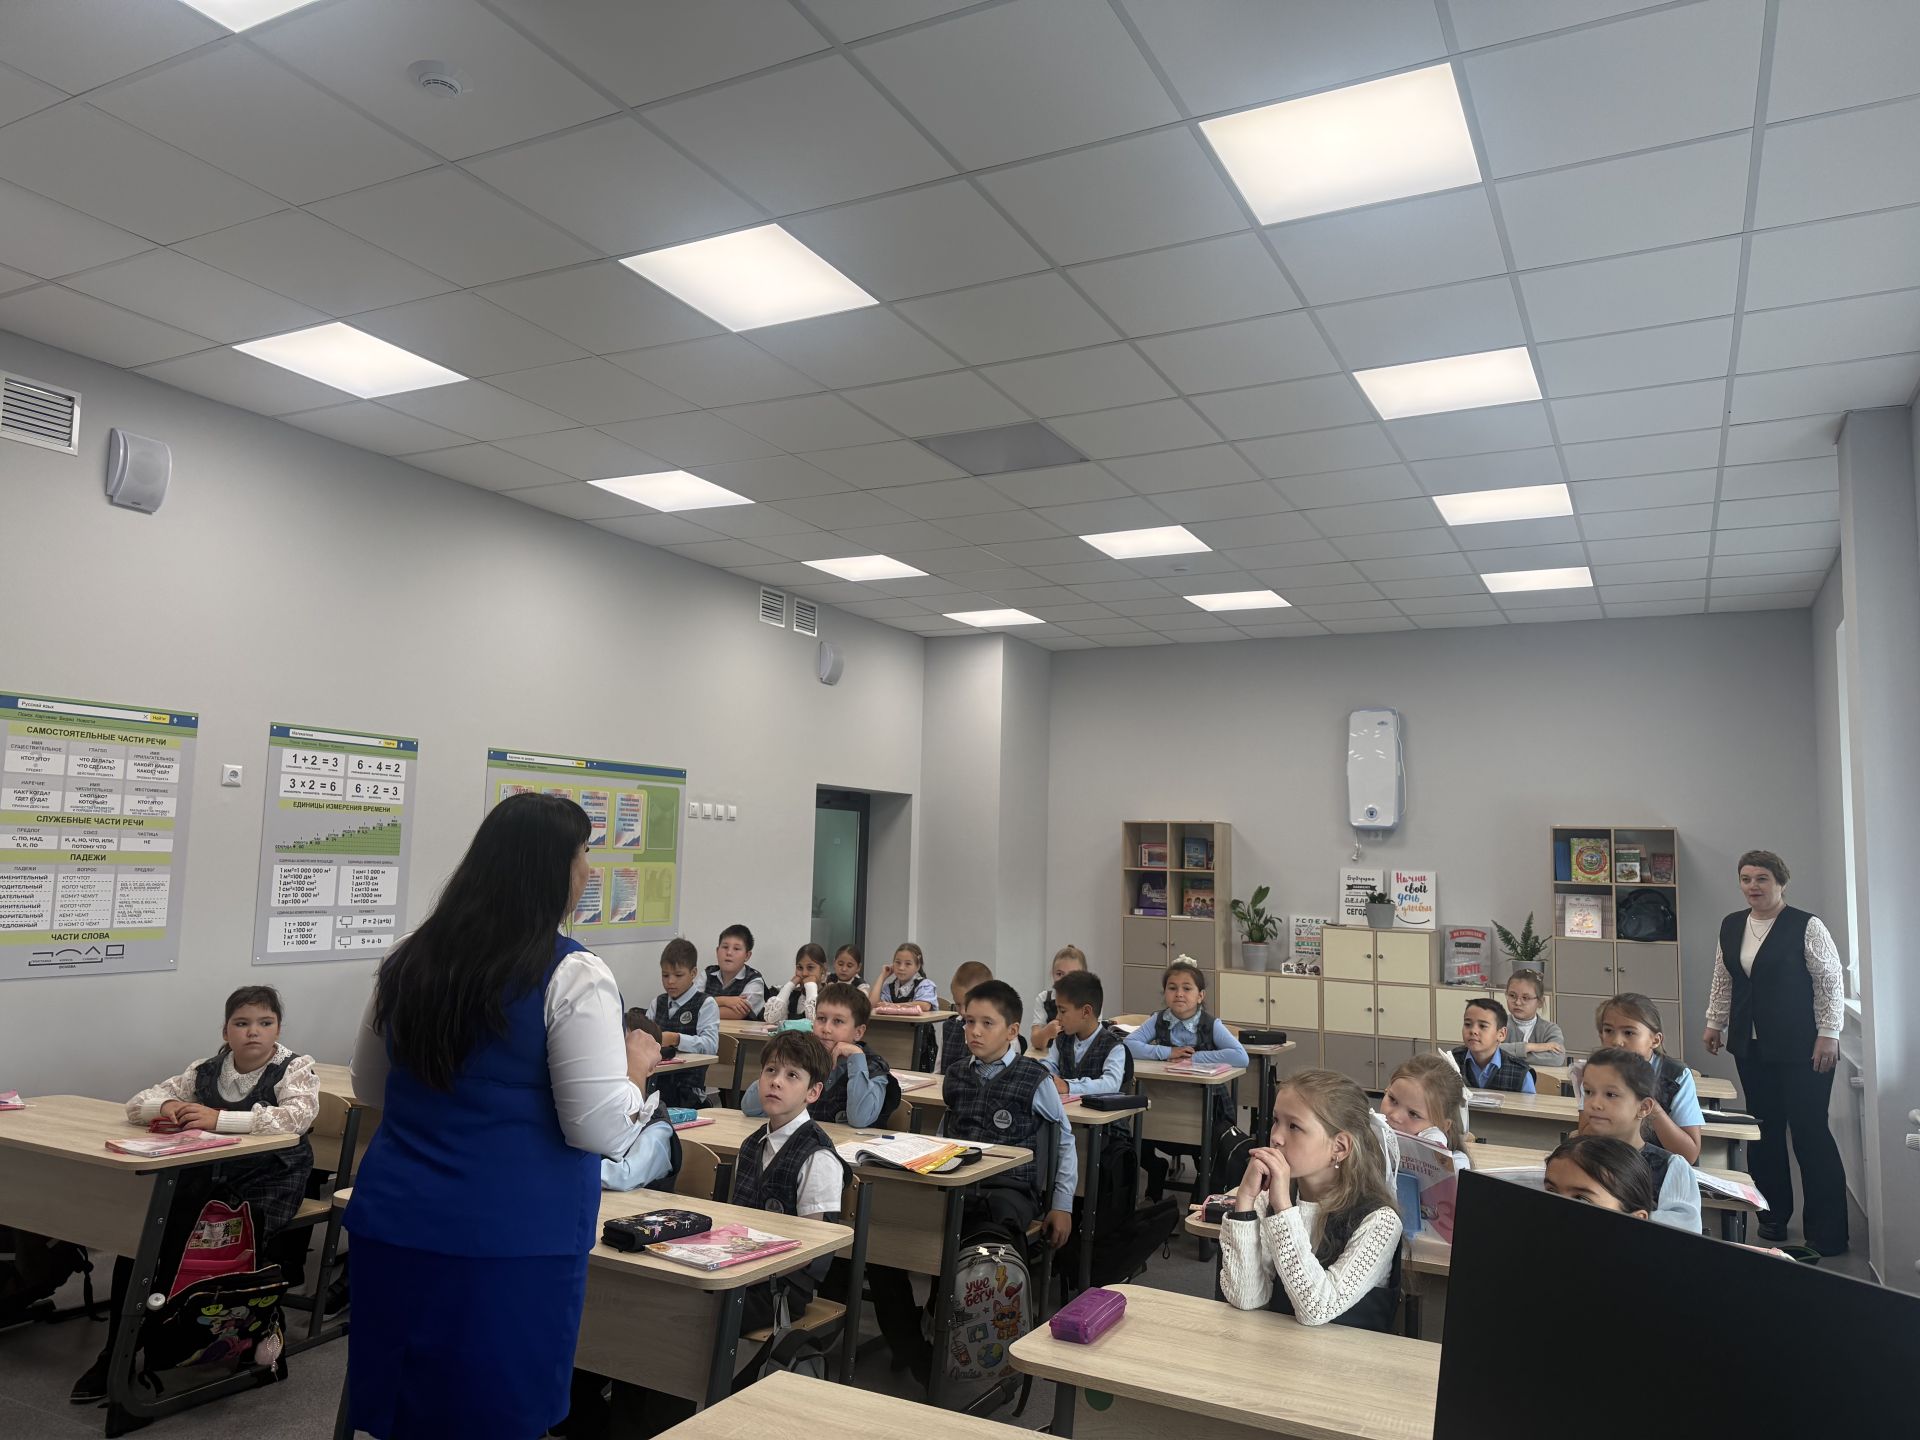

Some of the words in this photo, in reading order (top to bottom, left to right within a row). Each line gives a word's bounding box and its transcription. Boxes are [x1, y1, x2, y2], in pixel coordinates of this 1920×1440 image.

[26, 726, 116, 740] САМОСТОЯТЕЛЬНЫЕ
[118, 736, 144, 744] ЧАСТИ
[10, 744, 62, 752] СУЩЕСТВИТЕЛЬНОЕ
[293, 754, 297, 764] 1
[311, 756, 317, 766] 2
[332, 758, 338, 767] 3
[358, 760, 363, 769] 6
[377, 762, 382, 771] 4
[394, 764, 400, 773] 2
[290, 778, 296, 788] 3
[309, 780, 315, 790] 2
[330, 782, 336, 791] 6
[356, 784, 361, 793] 6
[373, 785, 378, 794] 2
[392, 786, 398, 796] 3
[293, 802, 324, 810] ЕДИНИЦЫ
[326, 803, 362, 811] ИЗМЕРЕНИЯ
[36, 816, 92, 824] СЛУЖЕБНЫЕ
[70, 854, 106, 862] ПАДЕЖИ
[1396, 872, 1428, 884] Начни
[1404, 882, 1428, 894] свой
[1398, 892, 1420, 906] день
